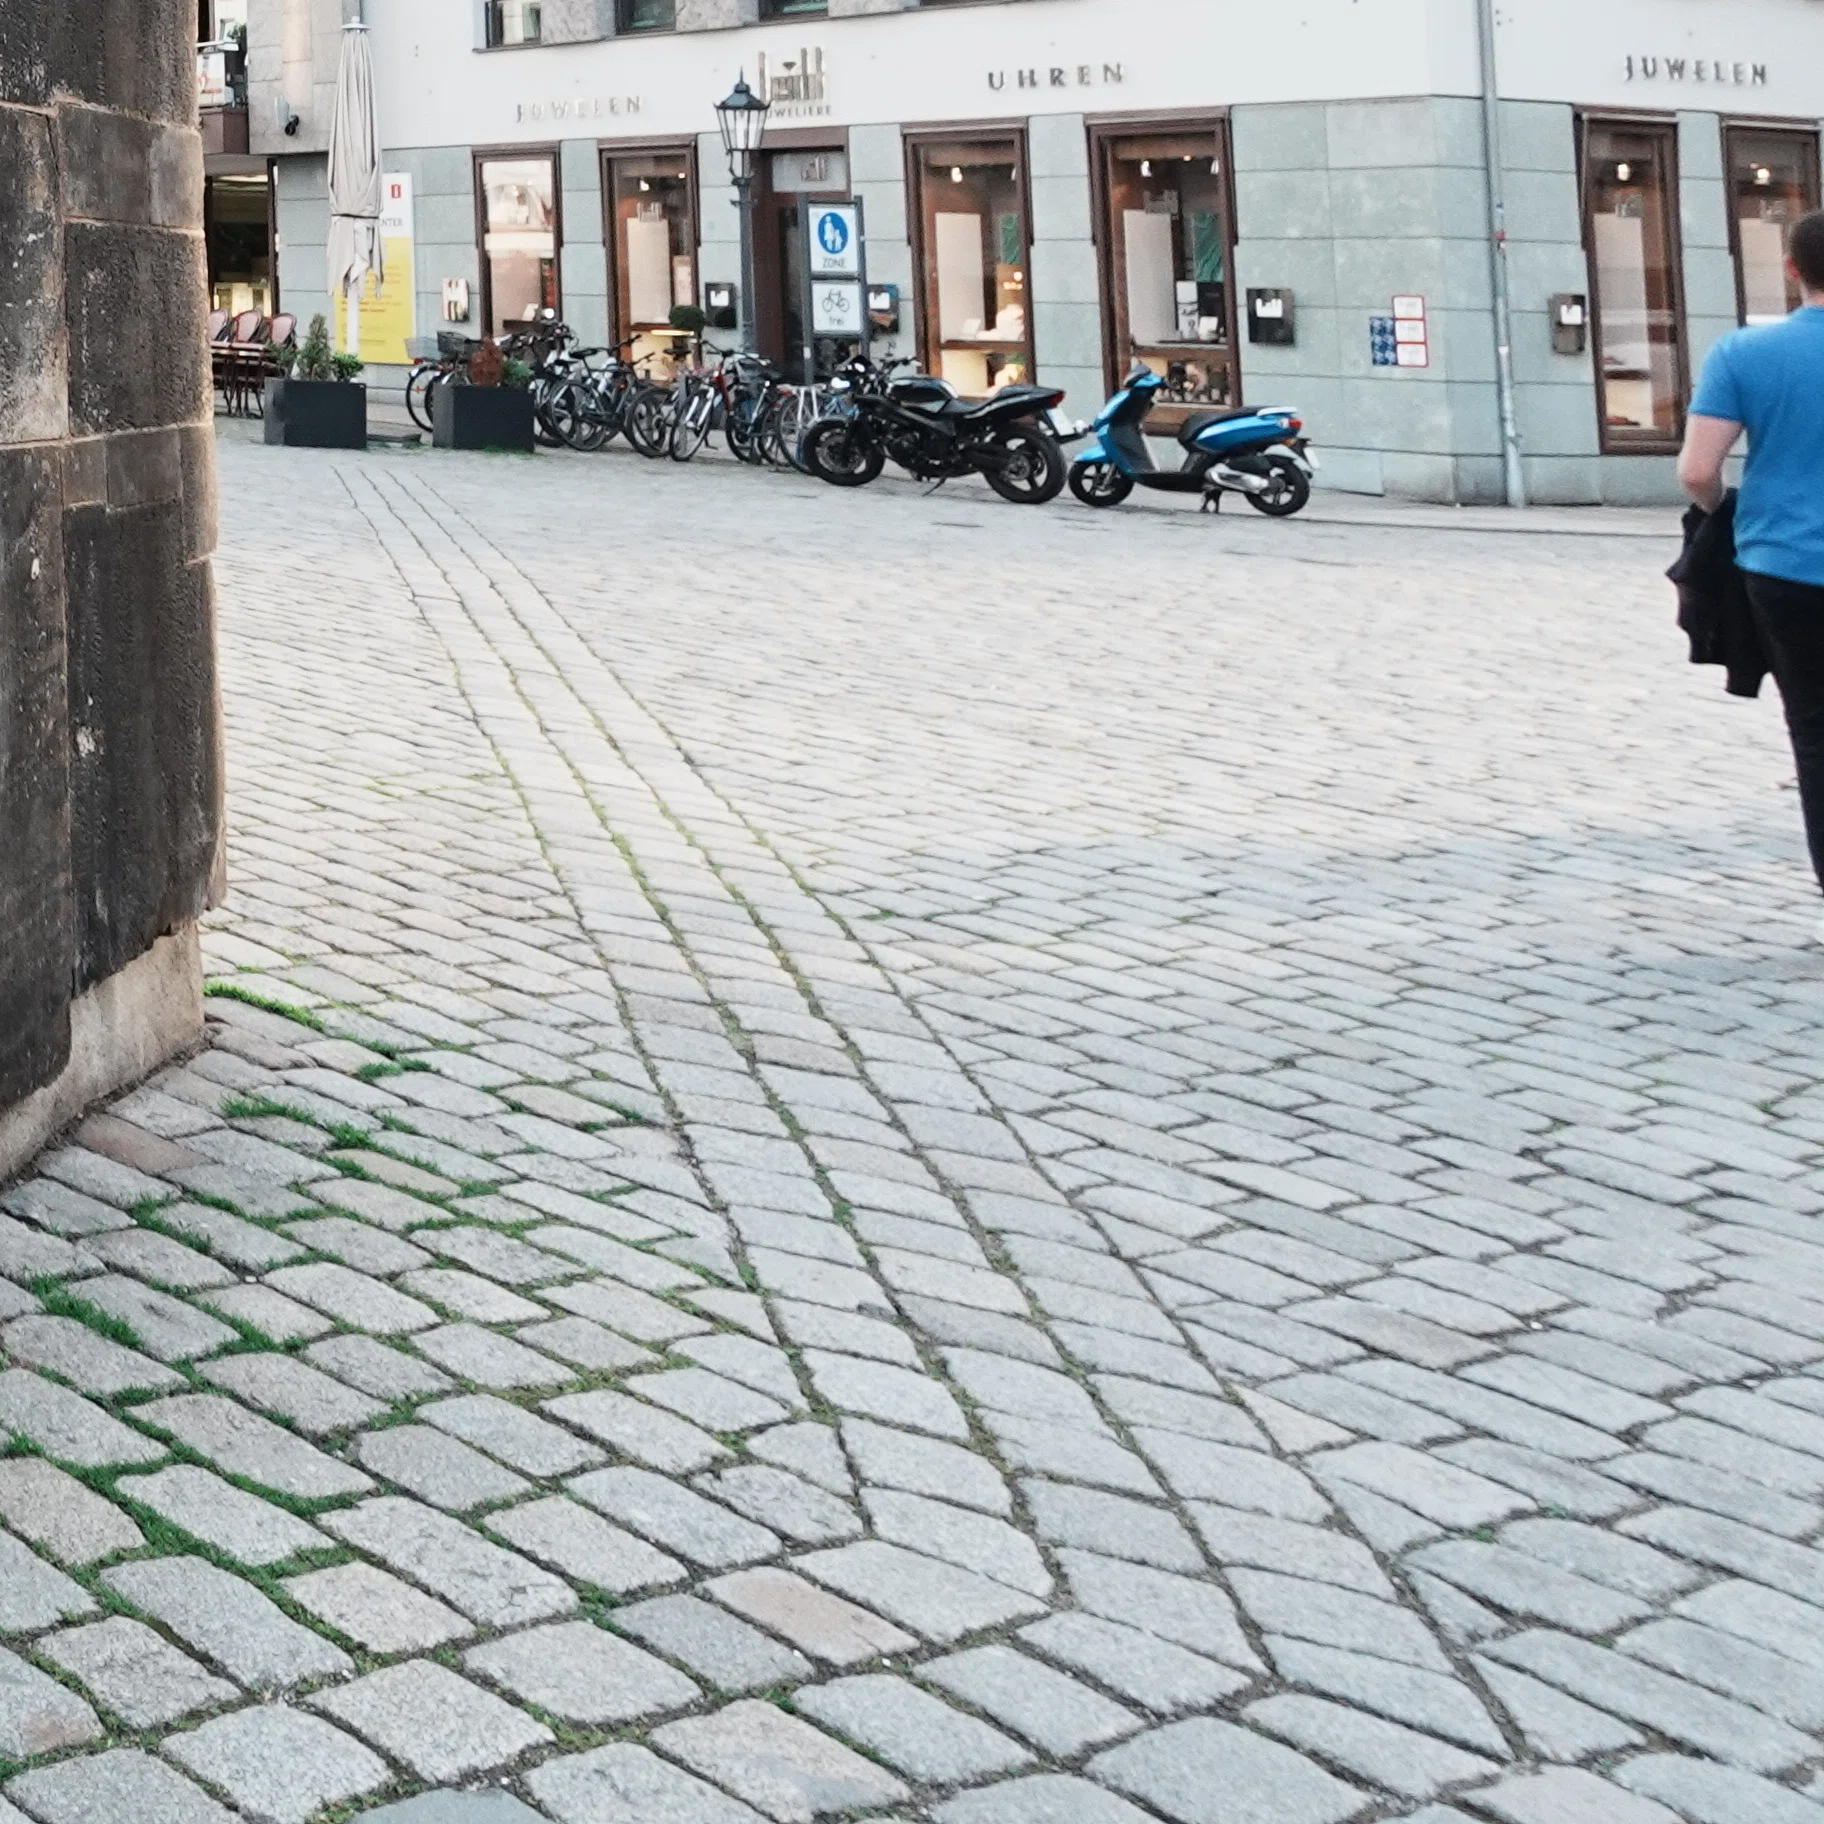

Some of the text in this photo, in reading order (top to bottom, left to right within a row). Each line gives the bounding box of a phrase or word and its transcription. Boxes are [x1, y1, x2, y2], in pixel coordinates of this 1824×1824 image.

[987, 62, 1123, 91] UHREN
[1625, 54, 1768, 86] JUWELEN
[516, 94, 640, 124] JUWELEN
[822, 257, 845, 269] ZONE
